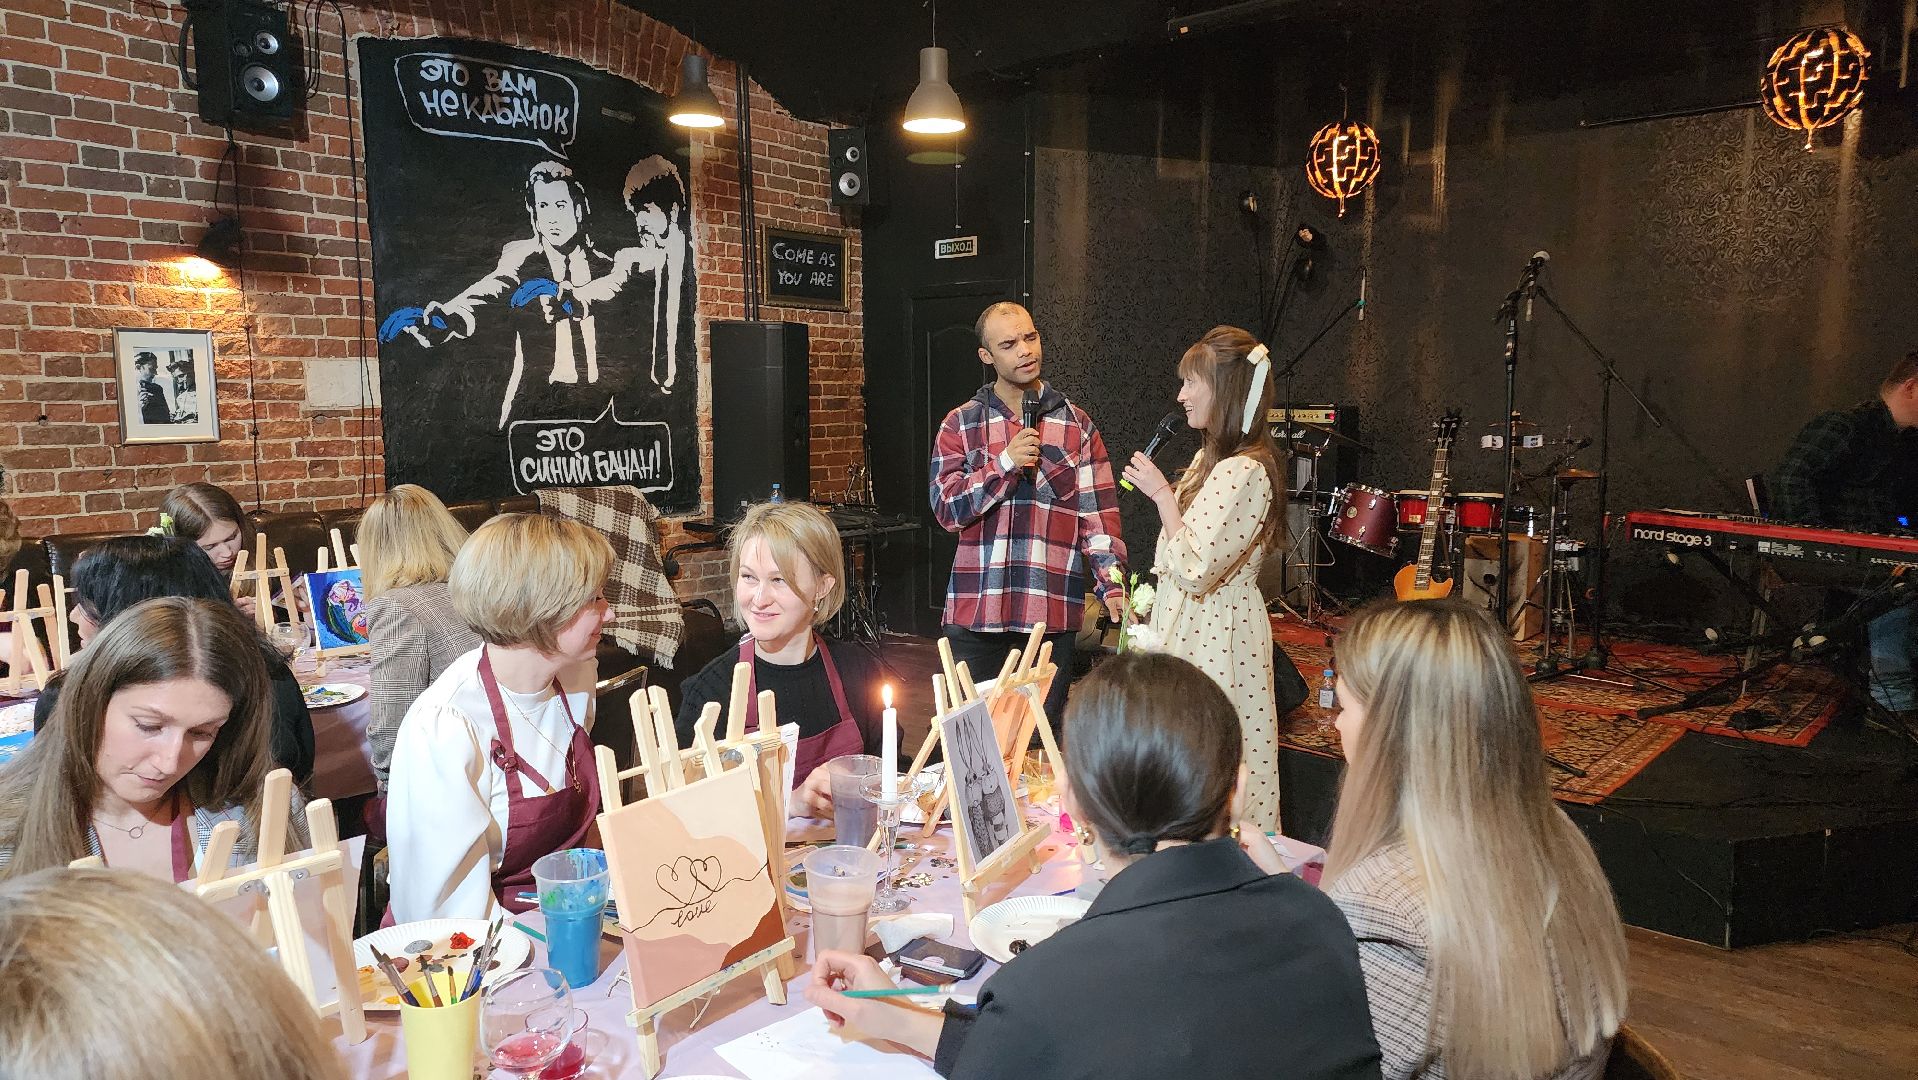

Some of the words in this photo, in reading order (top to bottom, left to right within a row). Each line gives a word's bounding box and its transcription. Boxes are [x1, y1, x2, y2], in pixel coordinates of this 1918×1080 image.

[420, 59, 469, 87] ЭТО
[482, 67, 538, 102] ВАМ
[772, 242, 814, 266] COME
[819, 251, 836, 267] AS
[940, 241, 973, 254] ВЫХОД
[777, 269, 802, 286] YOU
[810, 271, 834, 287] ARE
[536, 426, 584, 451] ЭТО
[520, 452, 593, 484] СИНИЙ
[593, 440, 661, 481] БАНАН!
[1634, 527, 1664, 541] nord
[1666, 532, 1703, 547] stage
[1703, 535, 1712, 547] 3
